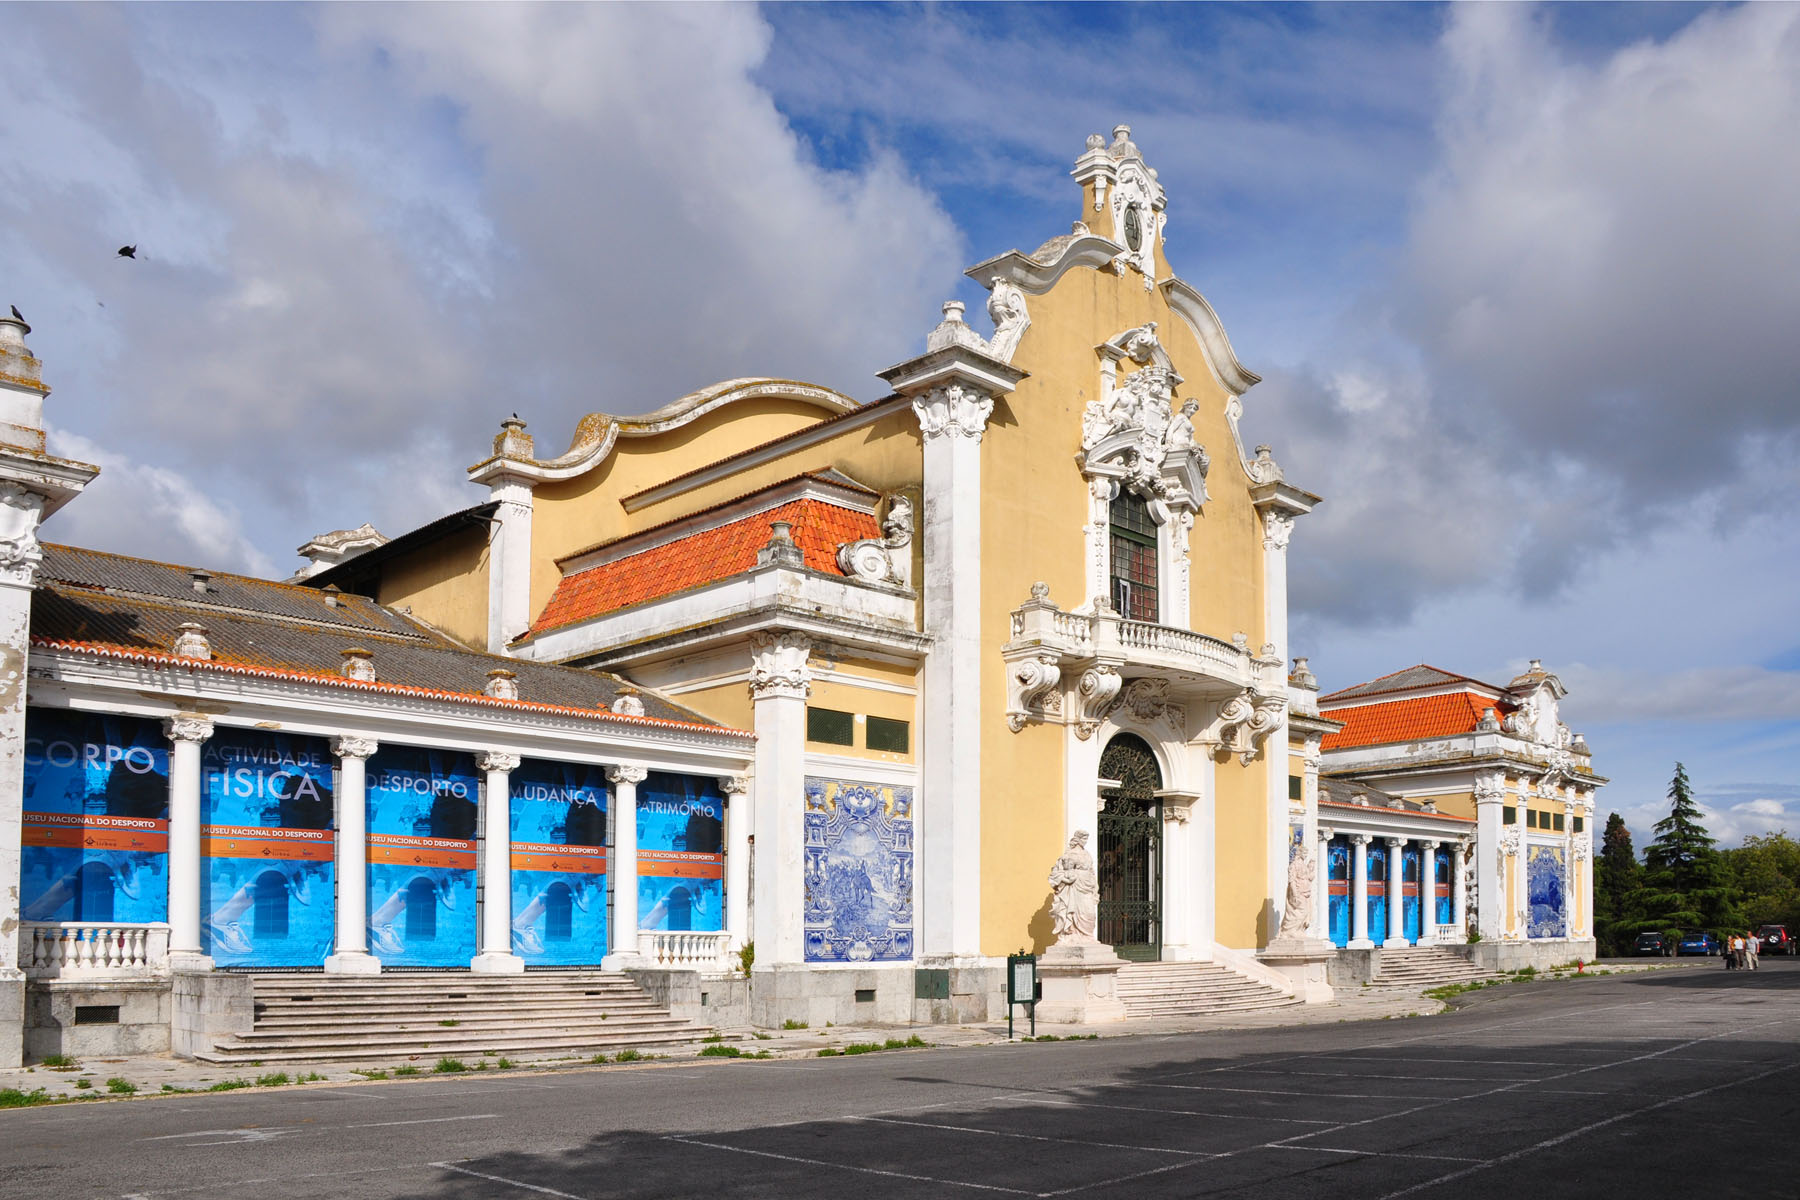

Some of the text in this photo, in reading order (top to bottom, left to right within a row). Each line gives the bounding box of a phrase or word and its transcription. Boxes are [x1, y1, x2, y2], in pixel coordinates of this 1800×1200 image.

[24, 738, 155, 775] CORPO
[204, 745, 321, 768] ACTIVIDADE
[365, 773, 468, 798] DESPORTO
[509, 784, 598, 808] MUDANÇA
[23, 814, 47, 822] USEU
[48, 815, 95, 825] NACIONAL
[111, 818, 156, 828] DESPORTO
[202, 827, 230, 835] MUSEU
[231, 828, 271, 837] NACIONAL
[285, 830, 323, 839] DESPORTO
[387, 836, 422, 846] NACIONAL
[434, 840, 468, 849] DESPORTO
[527, 844, 558, 852] NACIONAL
[569, 847, 599, 855] DESPORTO
[1328, 851, 1345, 866] ICA
